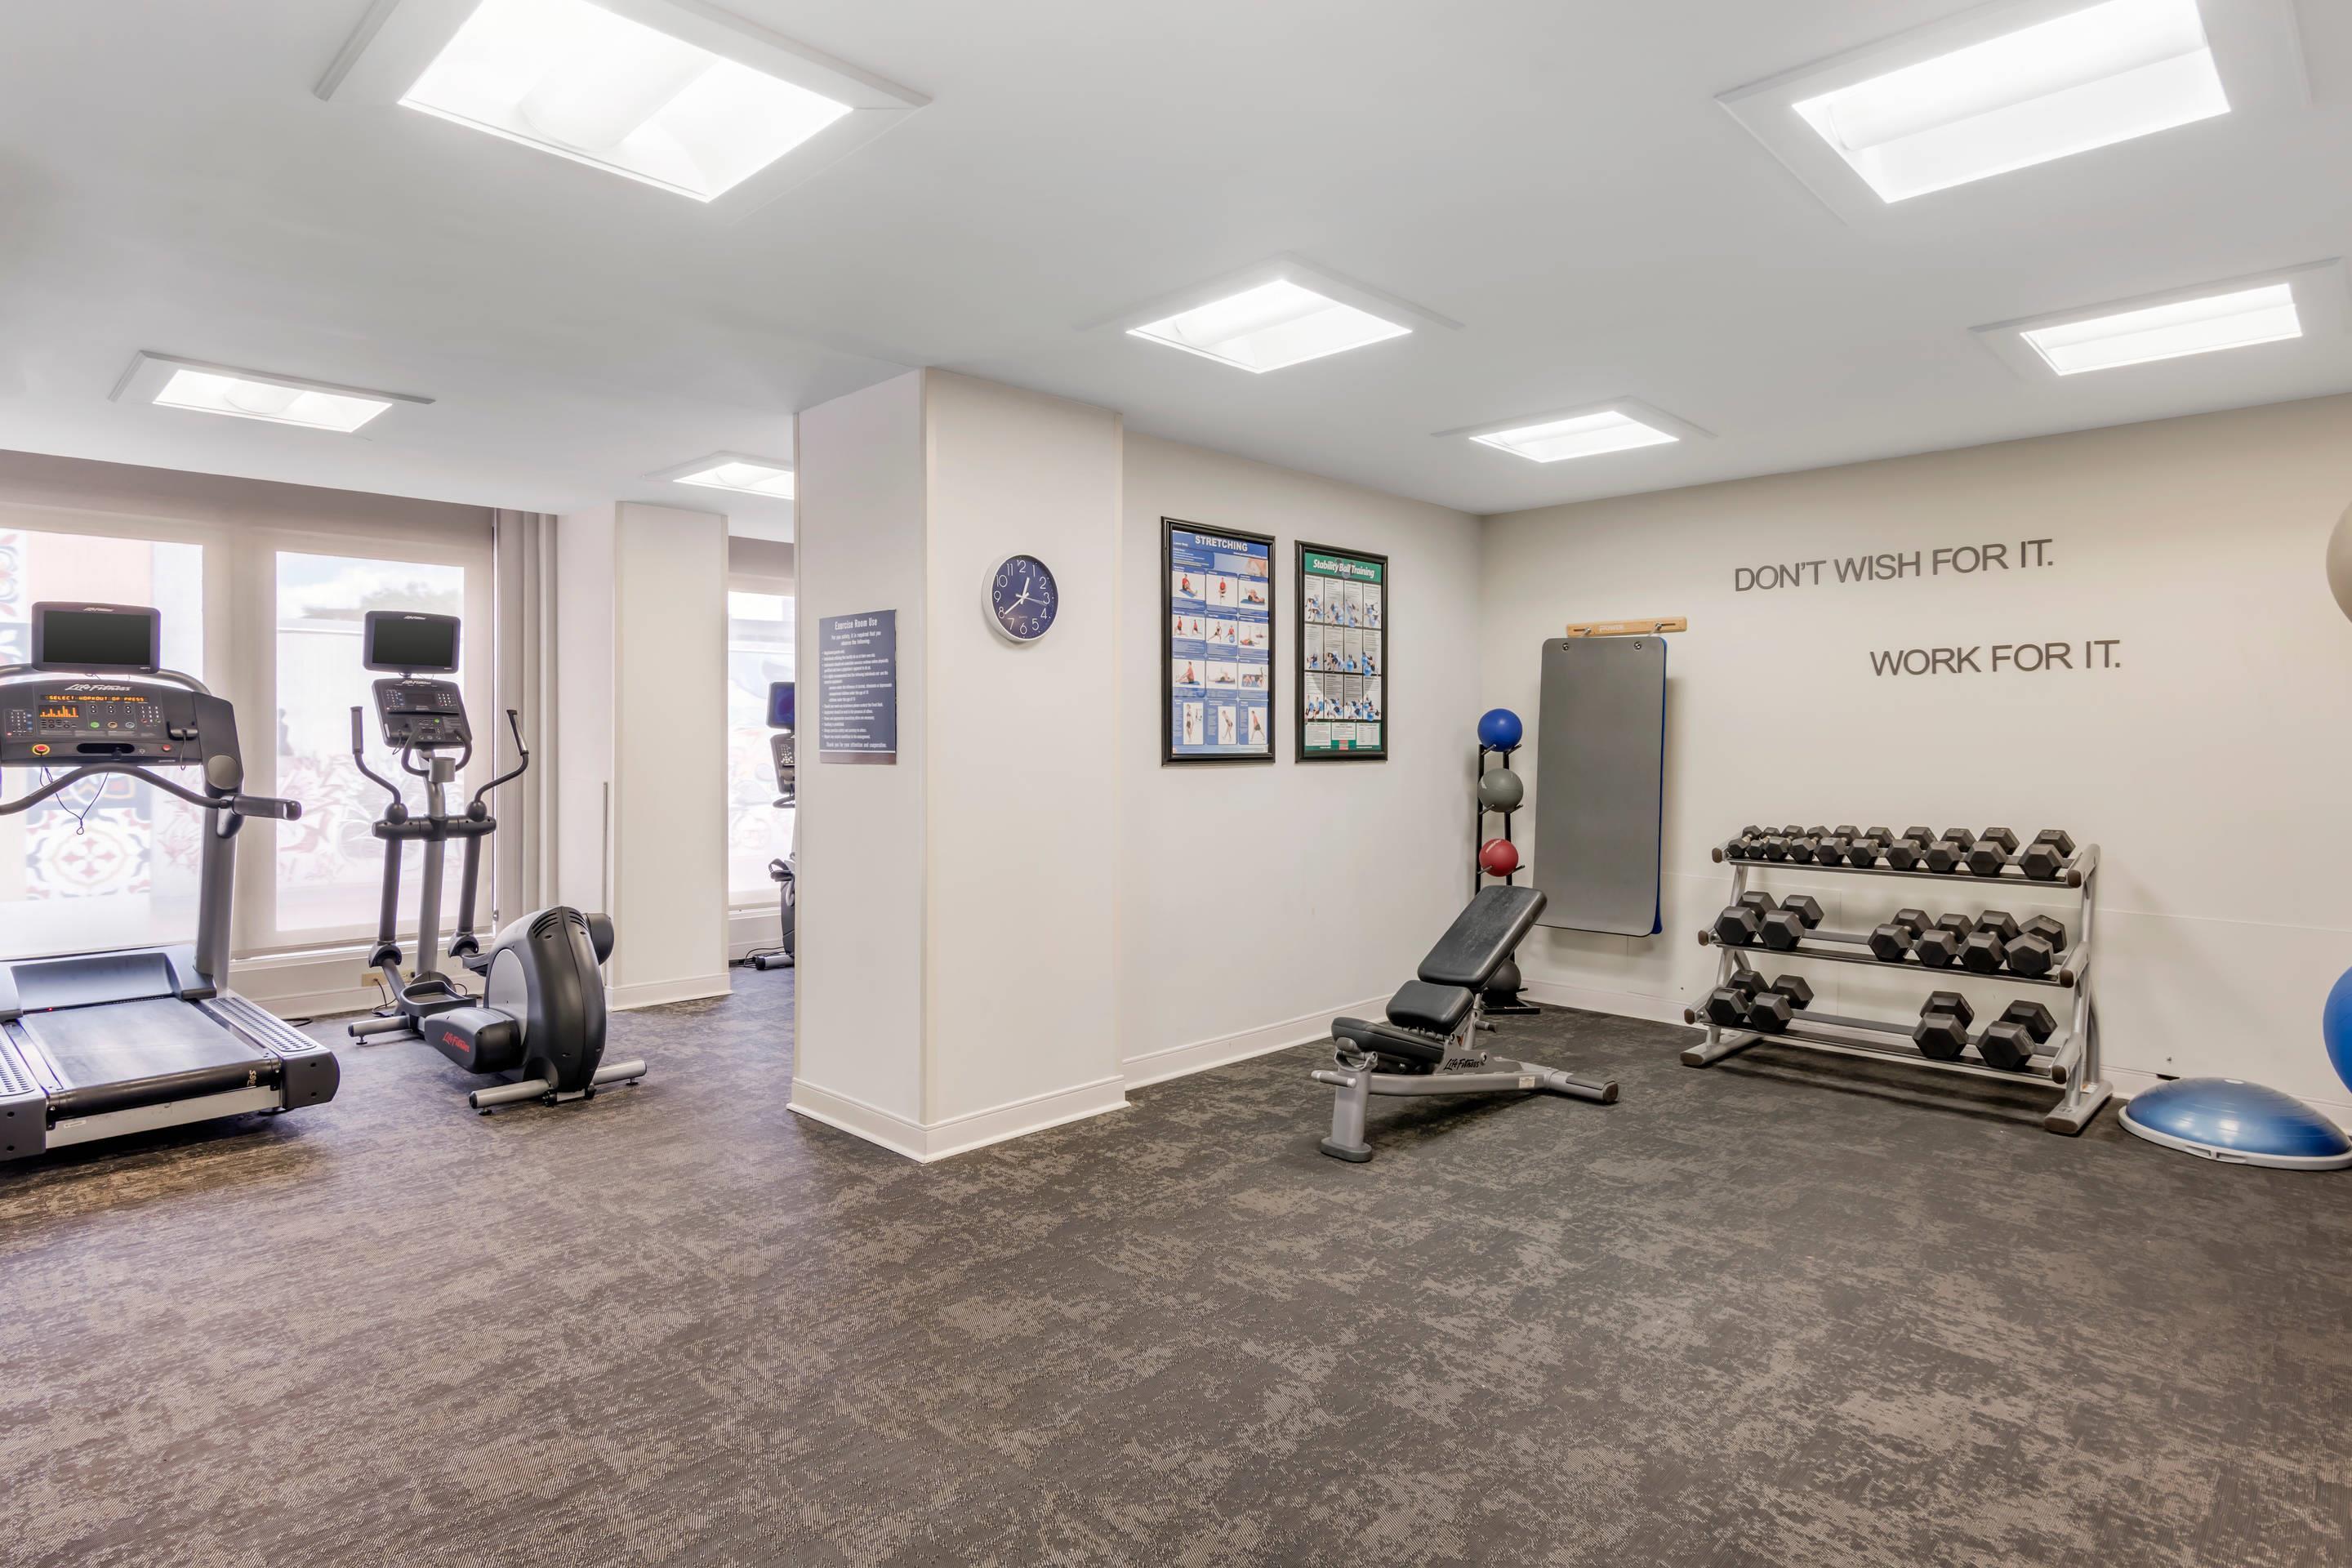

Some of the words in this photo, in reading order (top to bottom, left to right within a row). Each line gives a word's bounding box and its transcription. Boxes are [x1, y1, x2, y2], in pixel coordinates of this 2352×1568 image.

[1195, 535, 1248, 552] STRETCHING
[1007, 563, 1013, 577] 11
[1017, 559, 1027, 573] 12
[1313, 559, 1339, 573] Stability
[1339, 563, 1351, 572] Ball
[1351, 564, 1374, 579] Training
[1734, 560, 1827, 592] DON'T
[1833, 550, 1922, 583] WISH
[1931, 543, 2009, 576] FOR
[2020, 538, 2055, 568] IT.
[996, 574, 1008, 588] 10
[1039, 576, 1047, 589] 2
[993, 590, 1001, 603] 9
[1043, 592, 1050, 605] 3
[998, 606, 1005, 619] 8
[1040, 608, 1048, 619] 4
[835, 621, 853, 630] Exercise
[854, 619, 867, 628] Room
[868, 617, 878, 626] Use
[1007, 617, 1015, 630] 7
[1019, 622, 1027, 635] 6
[1031, 617, 1040, 630] 5
[1869, 646, 1982, 677] WORK
[1991, 642, 2074, 673] FOR
[2085, 639, 2121, 670] IT.
